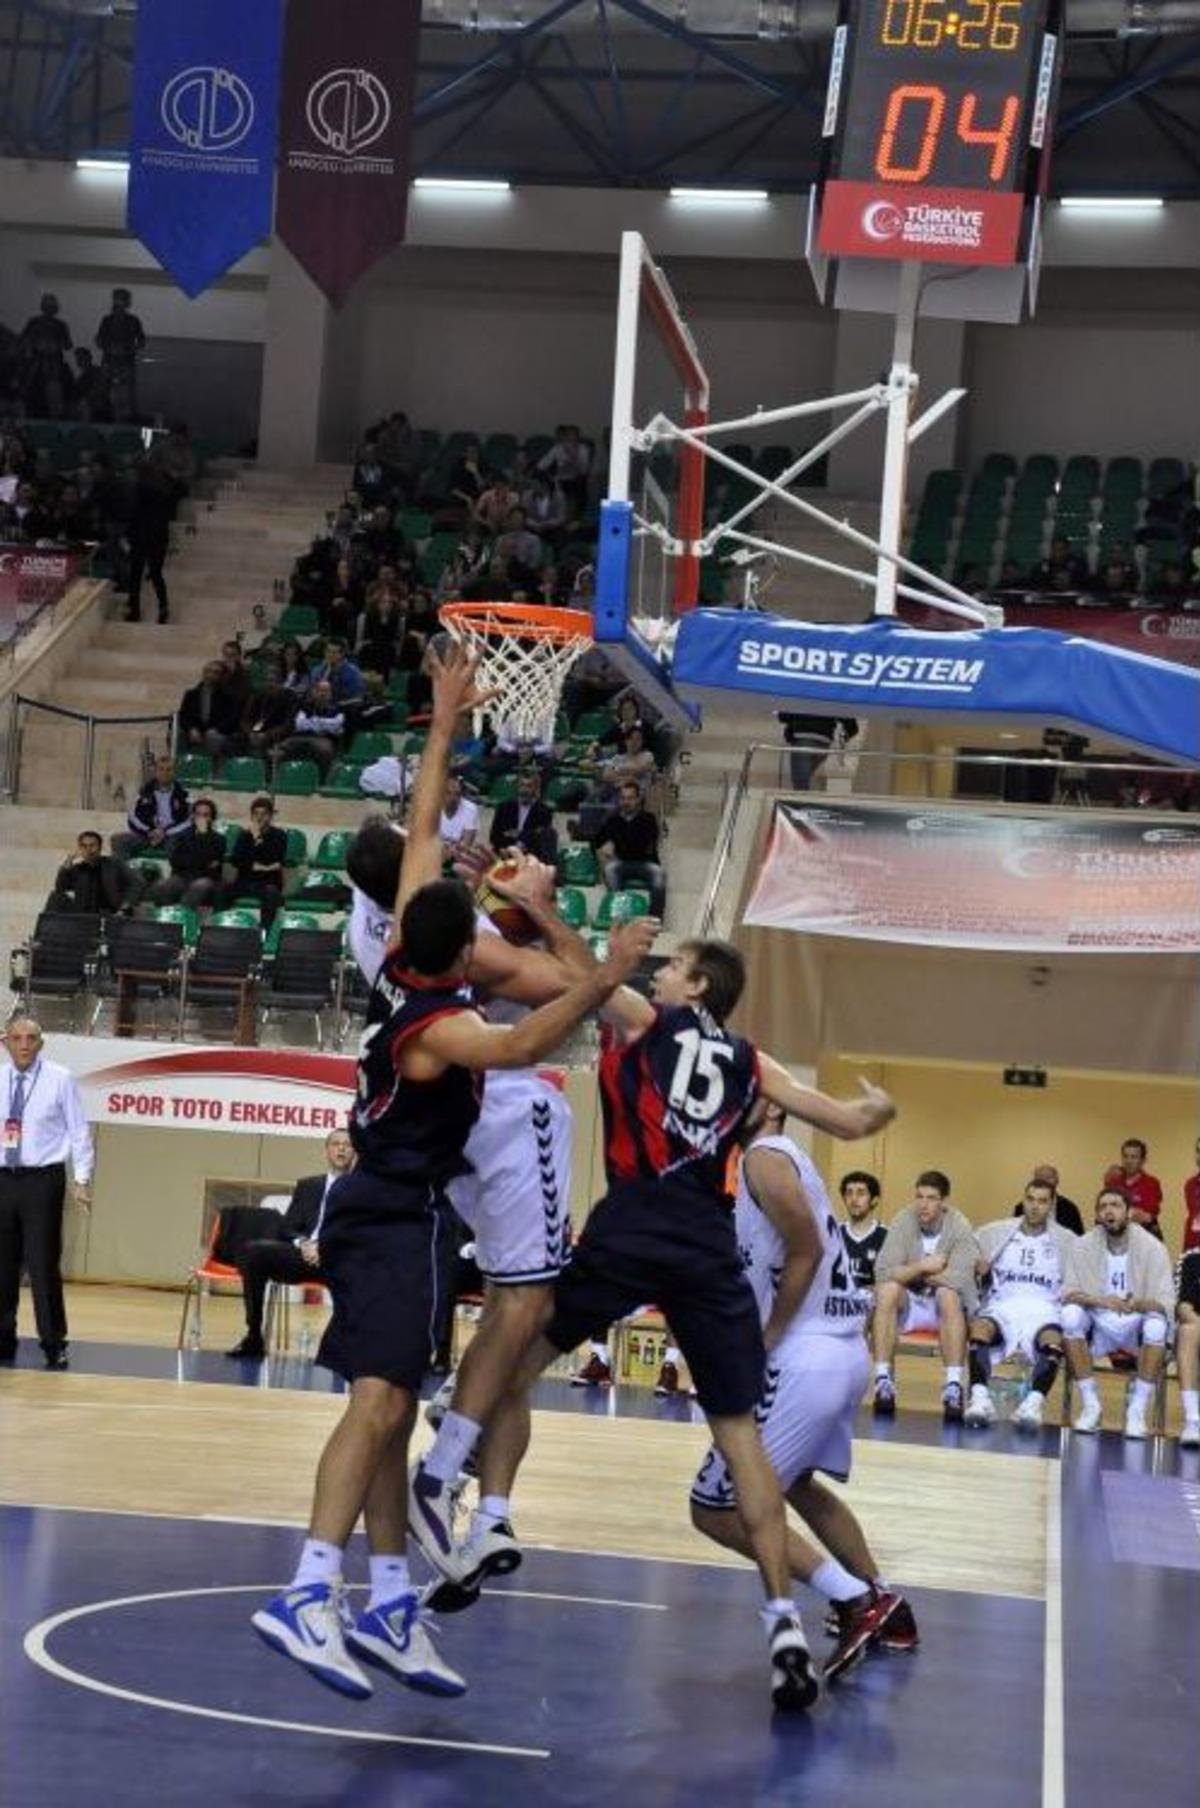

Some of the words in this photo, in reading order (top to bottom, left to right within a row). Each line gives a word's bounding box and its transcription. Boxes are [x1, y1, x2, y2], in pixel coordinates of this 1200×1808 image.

[881, 0, 1022, 49] 06:26
[876, 84, 1020, 182] 04
[905, 204, 984, 226] TÜRKİYE
[739, 640, 848, 674] SPORT
[849, 653, 985, 685] SYSTEM
[668, 1027, 735, 1121] 15
[108, 1093, 164, 1117] SPOR
[172, 1098, 223, 1119] TOTO
[230, 1101, 337, 1128] ERKEKLER
[1020, 1248, 1036, 1267] 15
[1111, 1271, 1126, 1291] 41
